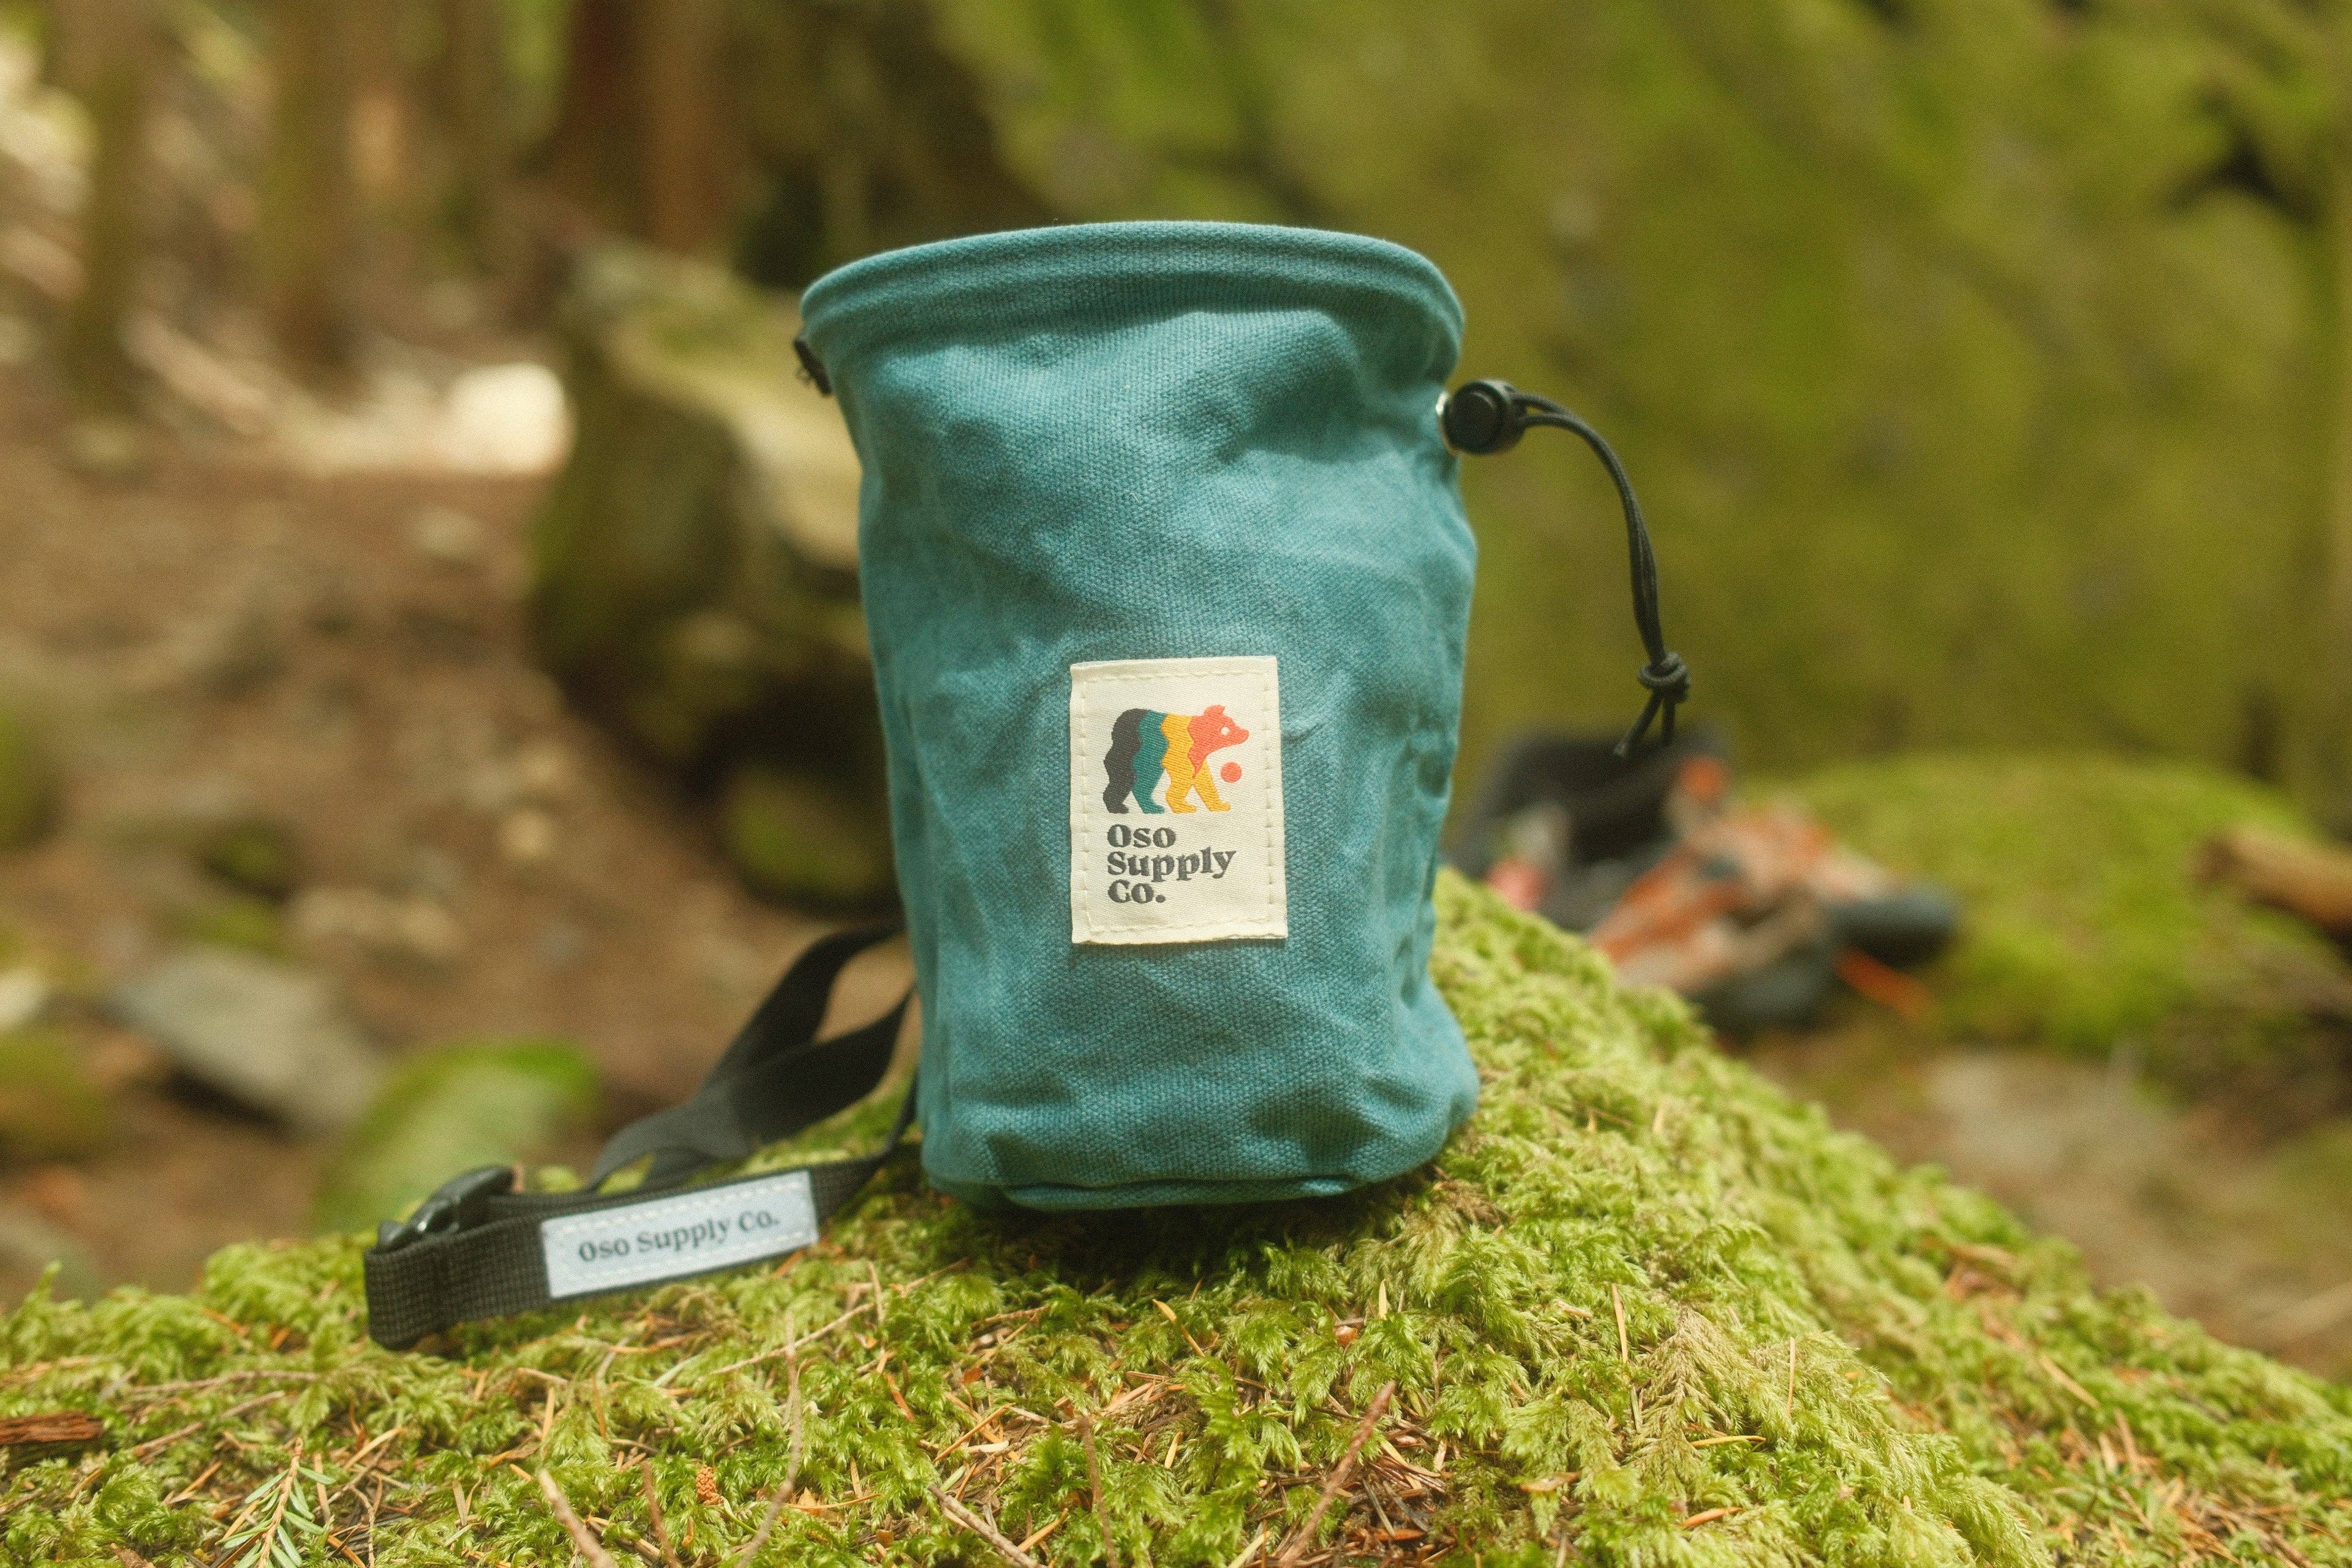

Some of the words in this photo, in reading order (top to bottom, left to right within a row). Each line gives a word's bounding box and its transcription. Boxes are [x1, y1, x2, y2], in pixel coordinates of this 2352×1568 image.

[1107, 824, 1176, 848] Oso
[1107, 847, 1236, 882] Supply
[1107, 880, 1166, 903] Co.
[578, 1238, 630, 1262] Oso
[636, 1217, 731, 1252] Supply
[737, 1209, 780, 1234] Co.
